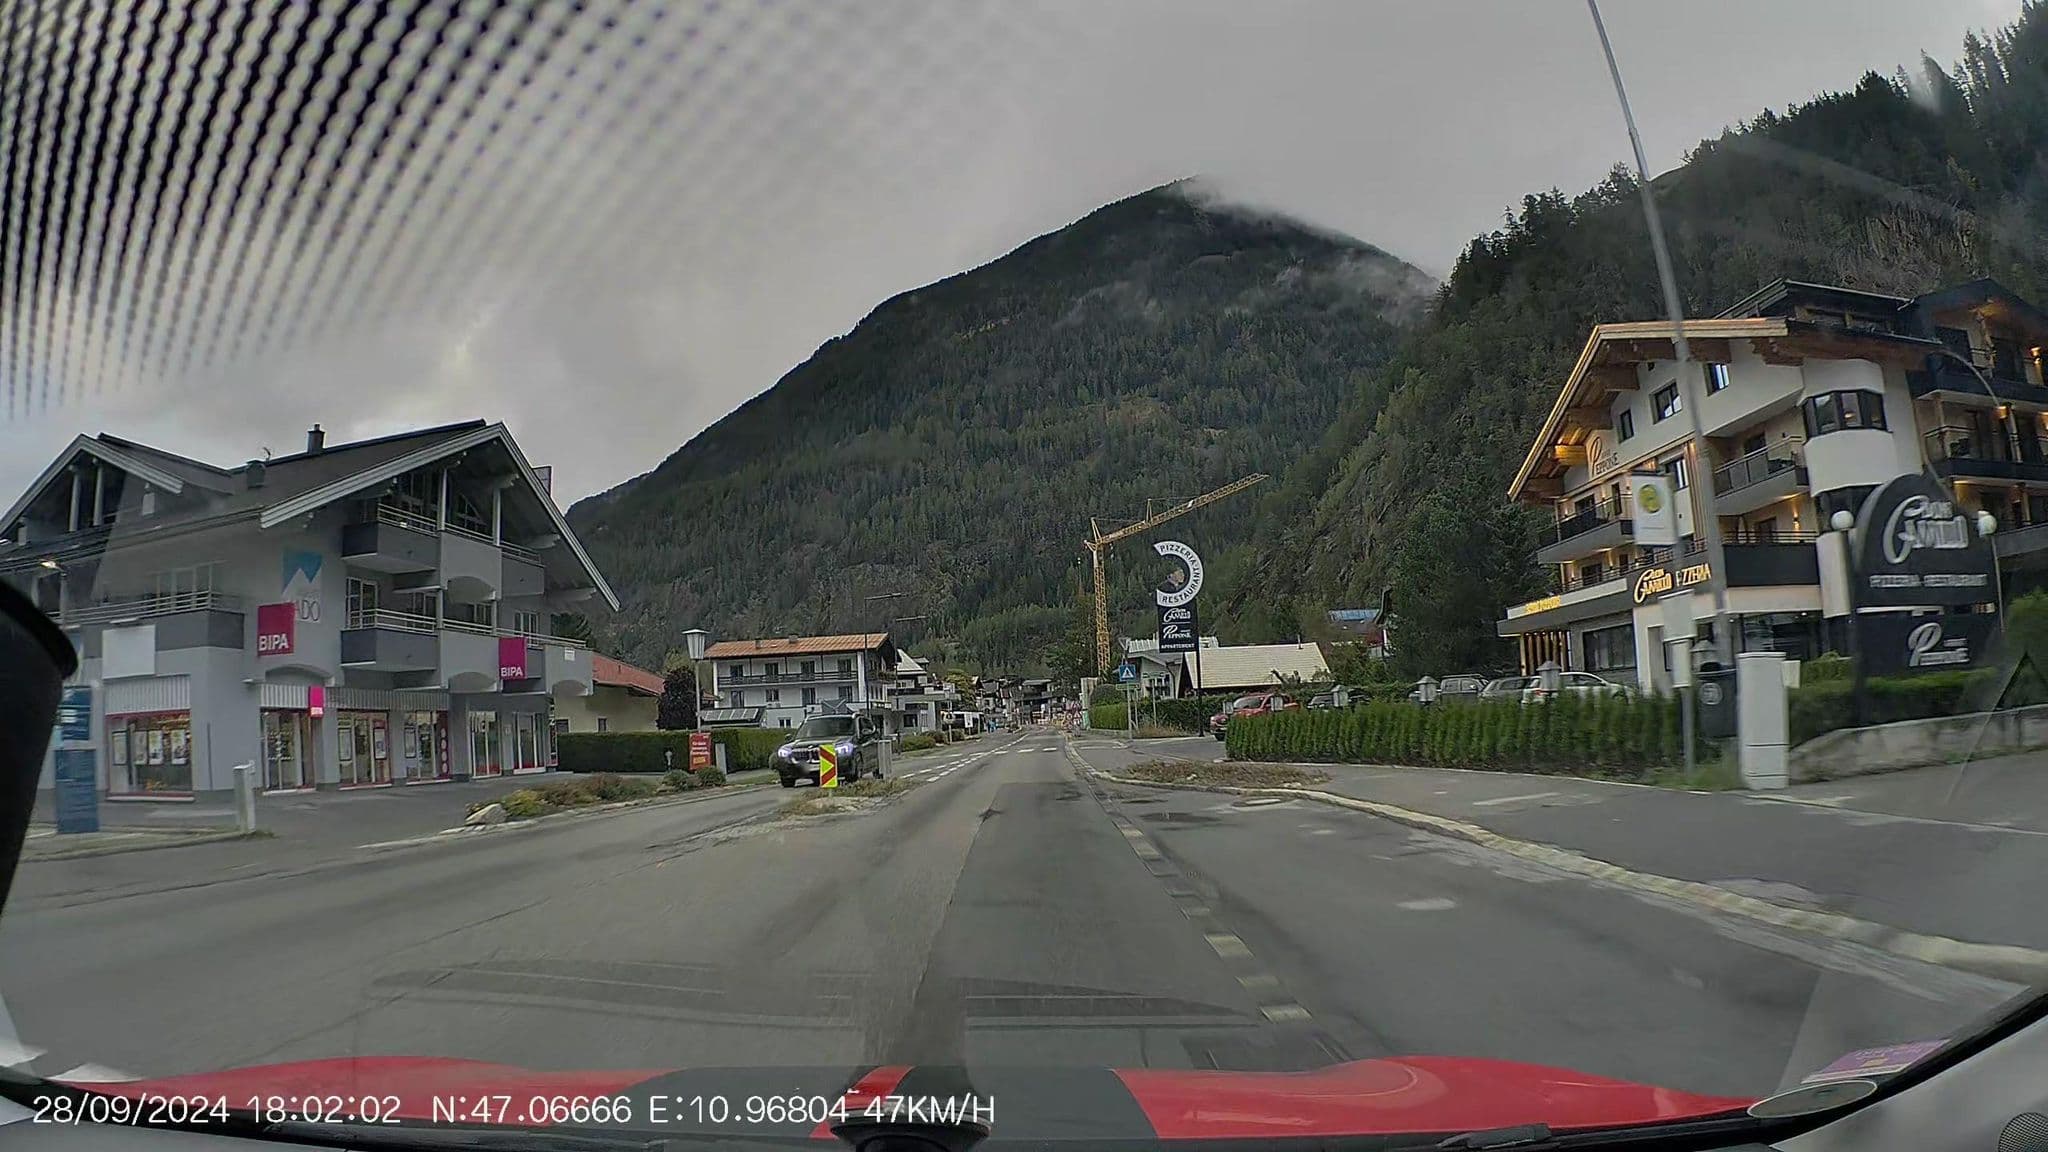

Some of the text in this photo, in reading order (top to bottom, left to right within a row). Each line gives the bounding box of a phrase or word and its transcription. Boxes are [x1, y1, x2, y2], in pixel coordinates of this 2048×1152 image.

[1159, 544, 1200, 604] PIZZERIA RESTAURANT
[1676, 563, 1711, 587] PZZERIA
[259, 634, 289, 651] BIPA
[501, 666, 524, 677] BIPA
